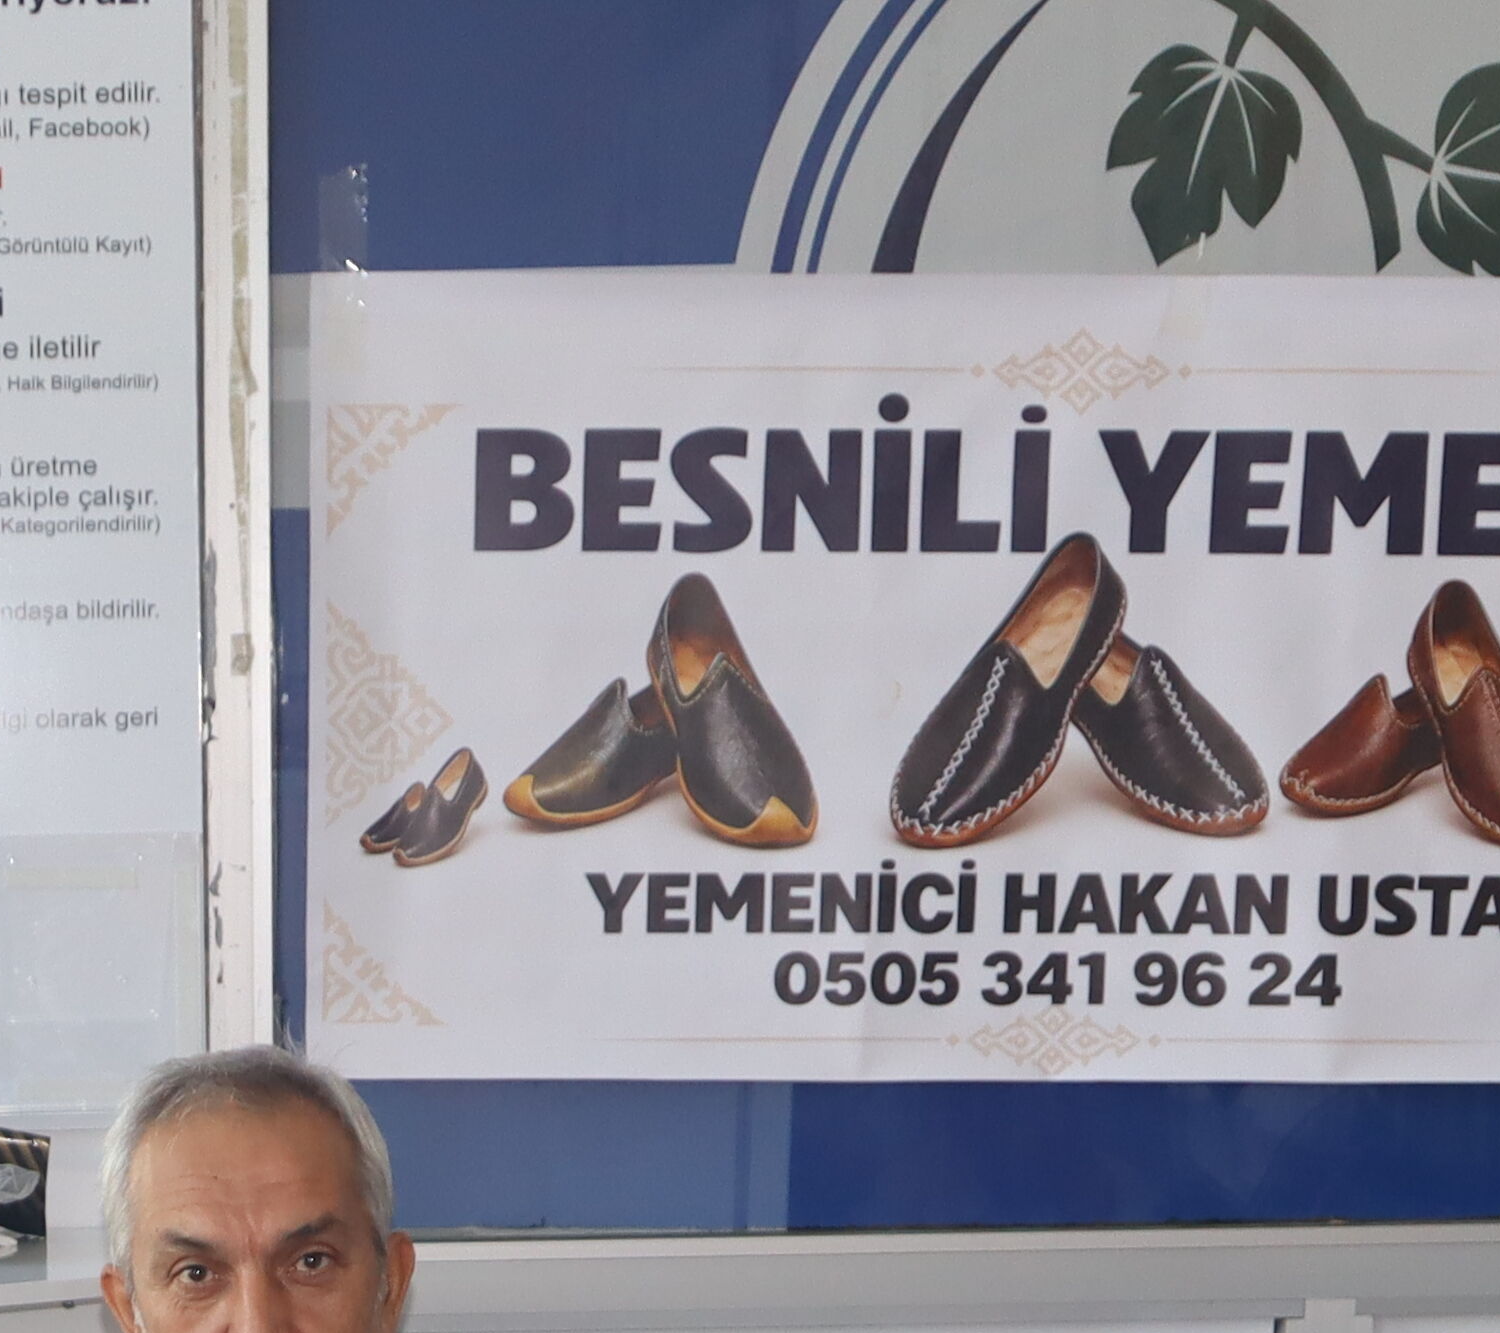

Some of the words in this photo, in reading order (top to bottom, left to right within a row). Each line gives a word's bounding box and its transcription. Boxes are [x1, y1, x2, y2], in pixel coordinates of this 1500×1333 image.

[19, 83, 86, 110] tespit
[95, 81, 159, 104] edilir.
[29, 117, 150, 140] Facebook)
[96, 236, 151, 257] Kayıt)
[30, 335, 101, 359] iletilir
[11, 456, 97, 477] üretme
[474, 393, 1051, 553] BESNİLİ
[79, 485, 157, 512] çalışır.
[77, 600, 159, 619] bildirilir.
[36, 708, 107, 728] olarak
[115, 706, 158, 732] geri
[585, 858, 978, 934] YEMENİCİ
[1003, 872, 1290, 935] HAKAN
[773, 951, 960, 1006] 0505
[981, 951, 1106, 1006] 341
[1133, 951, 1228, 1007] 96
[1248, 951, 1343, 1007] 24
